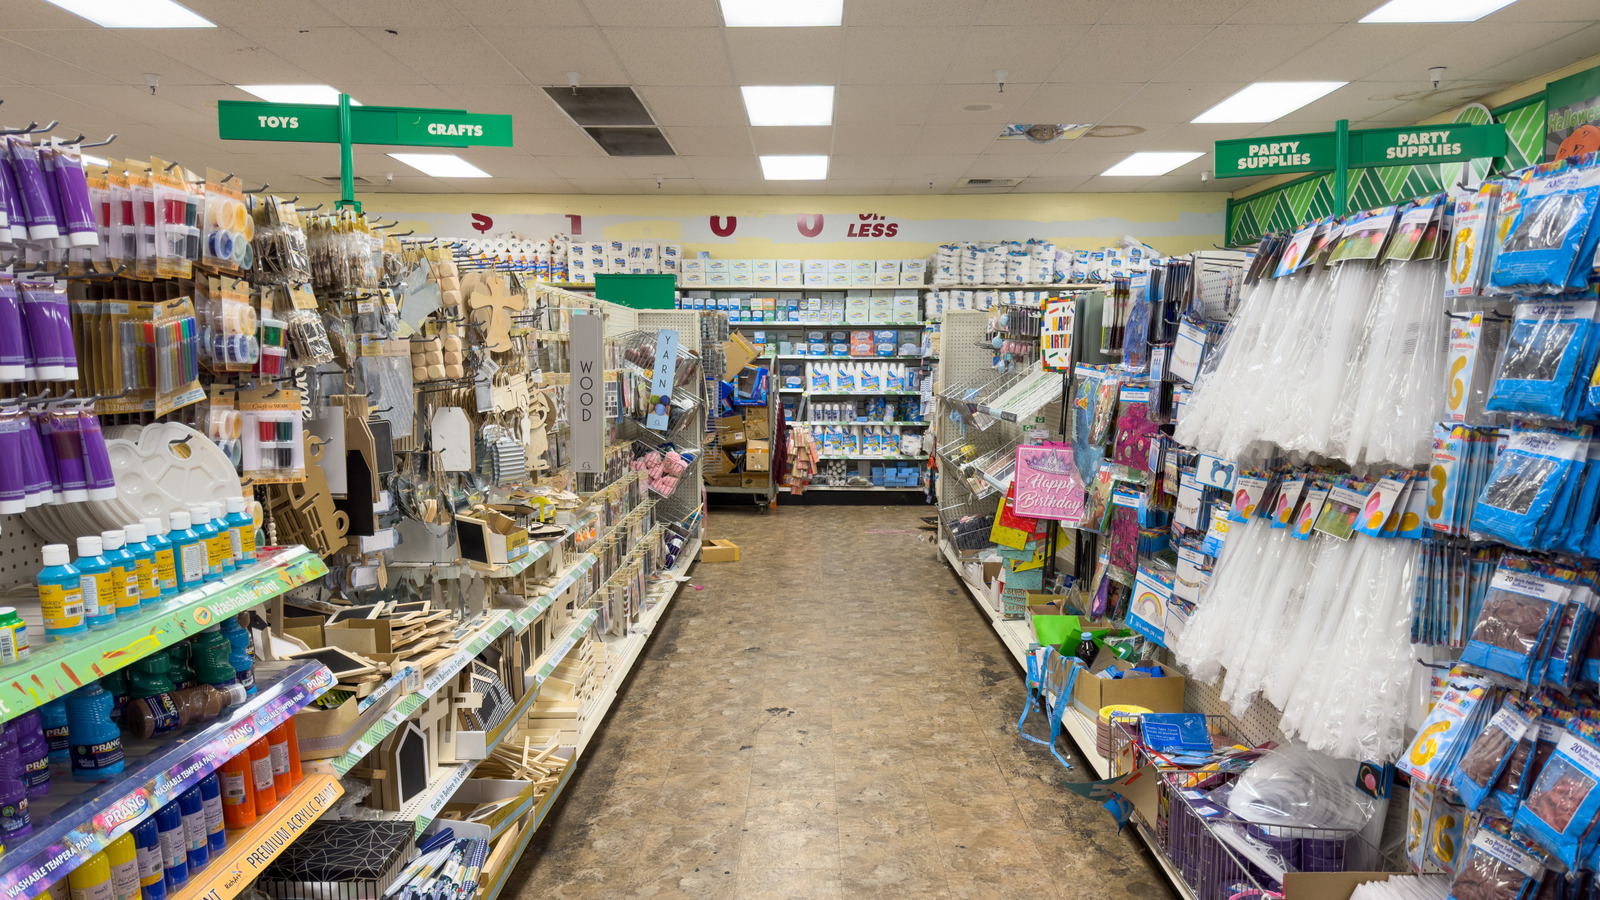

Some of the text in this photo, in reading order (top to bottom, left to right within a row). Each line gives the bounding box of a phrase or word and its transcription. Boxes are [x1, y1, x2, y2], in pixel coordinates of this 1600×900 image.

[258, 115, 299, 129] TOYS
[1547, 104, 1600, 134] Hallowee
[427, 123, 483, 137] CRAFTS
[1398, 131, 1450, 146] PARTY
[1249, 142, 1300, 156] PARTY
[1386, 143, 1462, 159] SUPPLIES
[1237, 153, 1311, 170] SUPPLIES
[847, 223, 899, 238] LESS
[1532, 305, 1545, 314] 20
[1052, 316, 1072, 332] HAPPY
[658, 335, 671, 389] YARN
[579, 360, 594, 422] WOOD
[1025, 472, 1075, 496] Happy
[1018, 490, 1081, 515] Birthday
[208, 589, 259, 617] Washable
[306, 670, 331, 691] PRANG
[426, 681, 438, 691] Grab
[440, 668, 452, 681] Before
[455, 655, 466, 667] Gone!
[160, 692, 178, 716] PRANG
[277, 698, 296, 714] TEMPERA
[293, 692, 305, 705] PAINT
[46, 726, 69, 737] PRA
[221, 722, 253, 748] PRANG
[91, 737, 120, 753] PRANG
[1570, 742, 1583, 753] 20
[25, 756, 49, 772] PRAN
[154, 751, 218, 798] WASHABLE TEMPERA PAINT
[430, 800, 443, 811] Grab
[442, 783, 456, 797] Before
[457, 765, 470, 779] Gone!
[104, 794, 146, 828] PRANG
[246, 826, 292, 870] PREMIUM
[286, 801, 320, 834] ACRYLIC
[314, 782, 338, 808] PAINT
[1485, 837, 1493, 845] 20
[6, 833, 96, 899] WASHABLE TEMPERA PAINT
